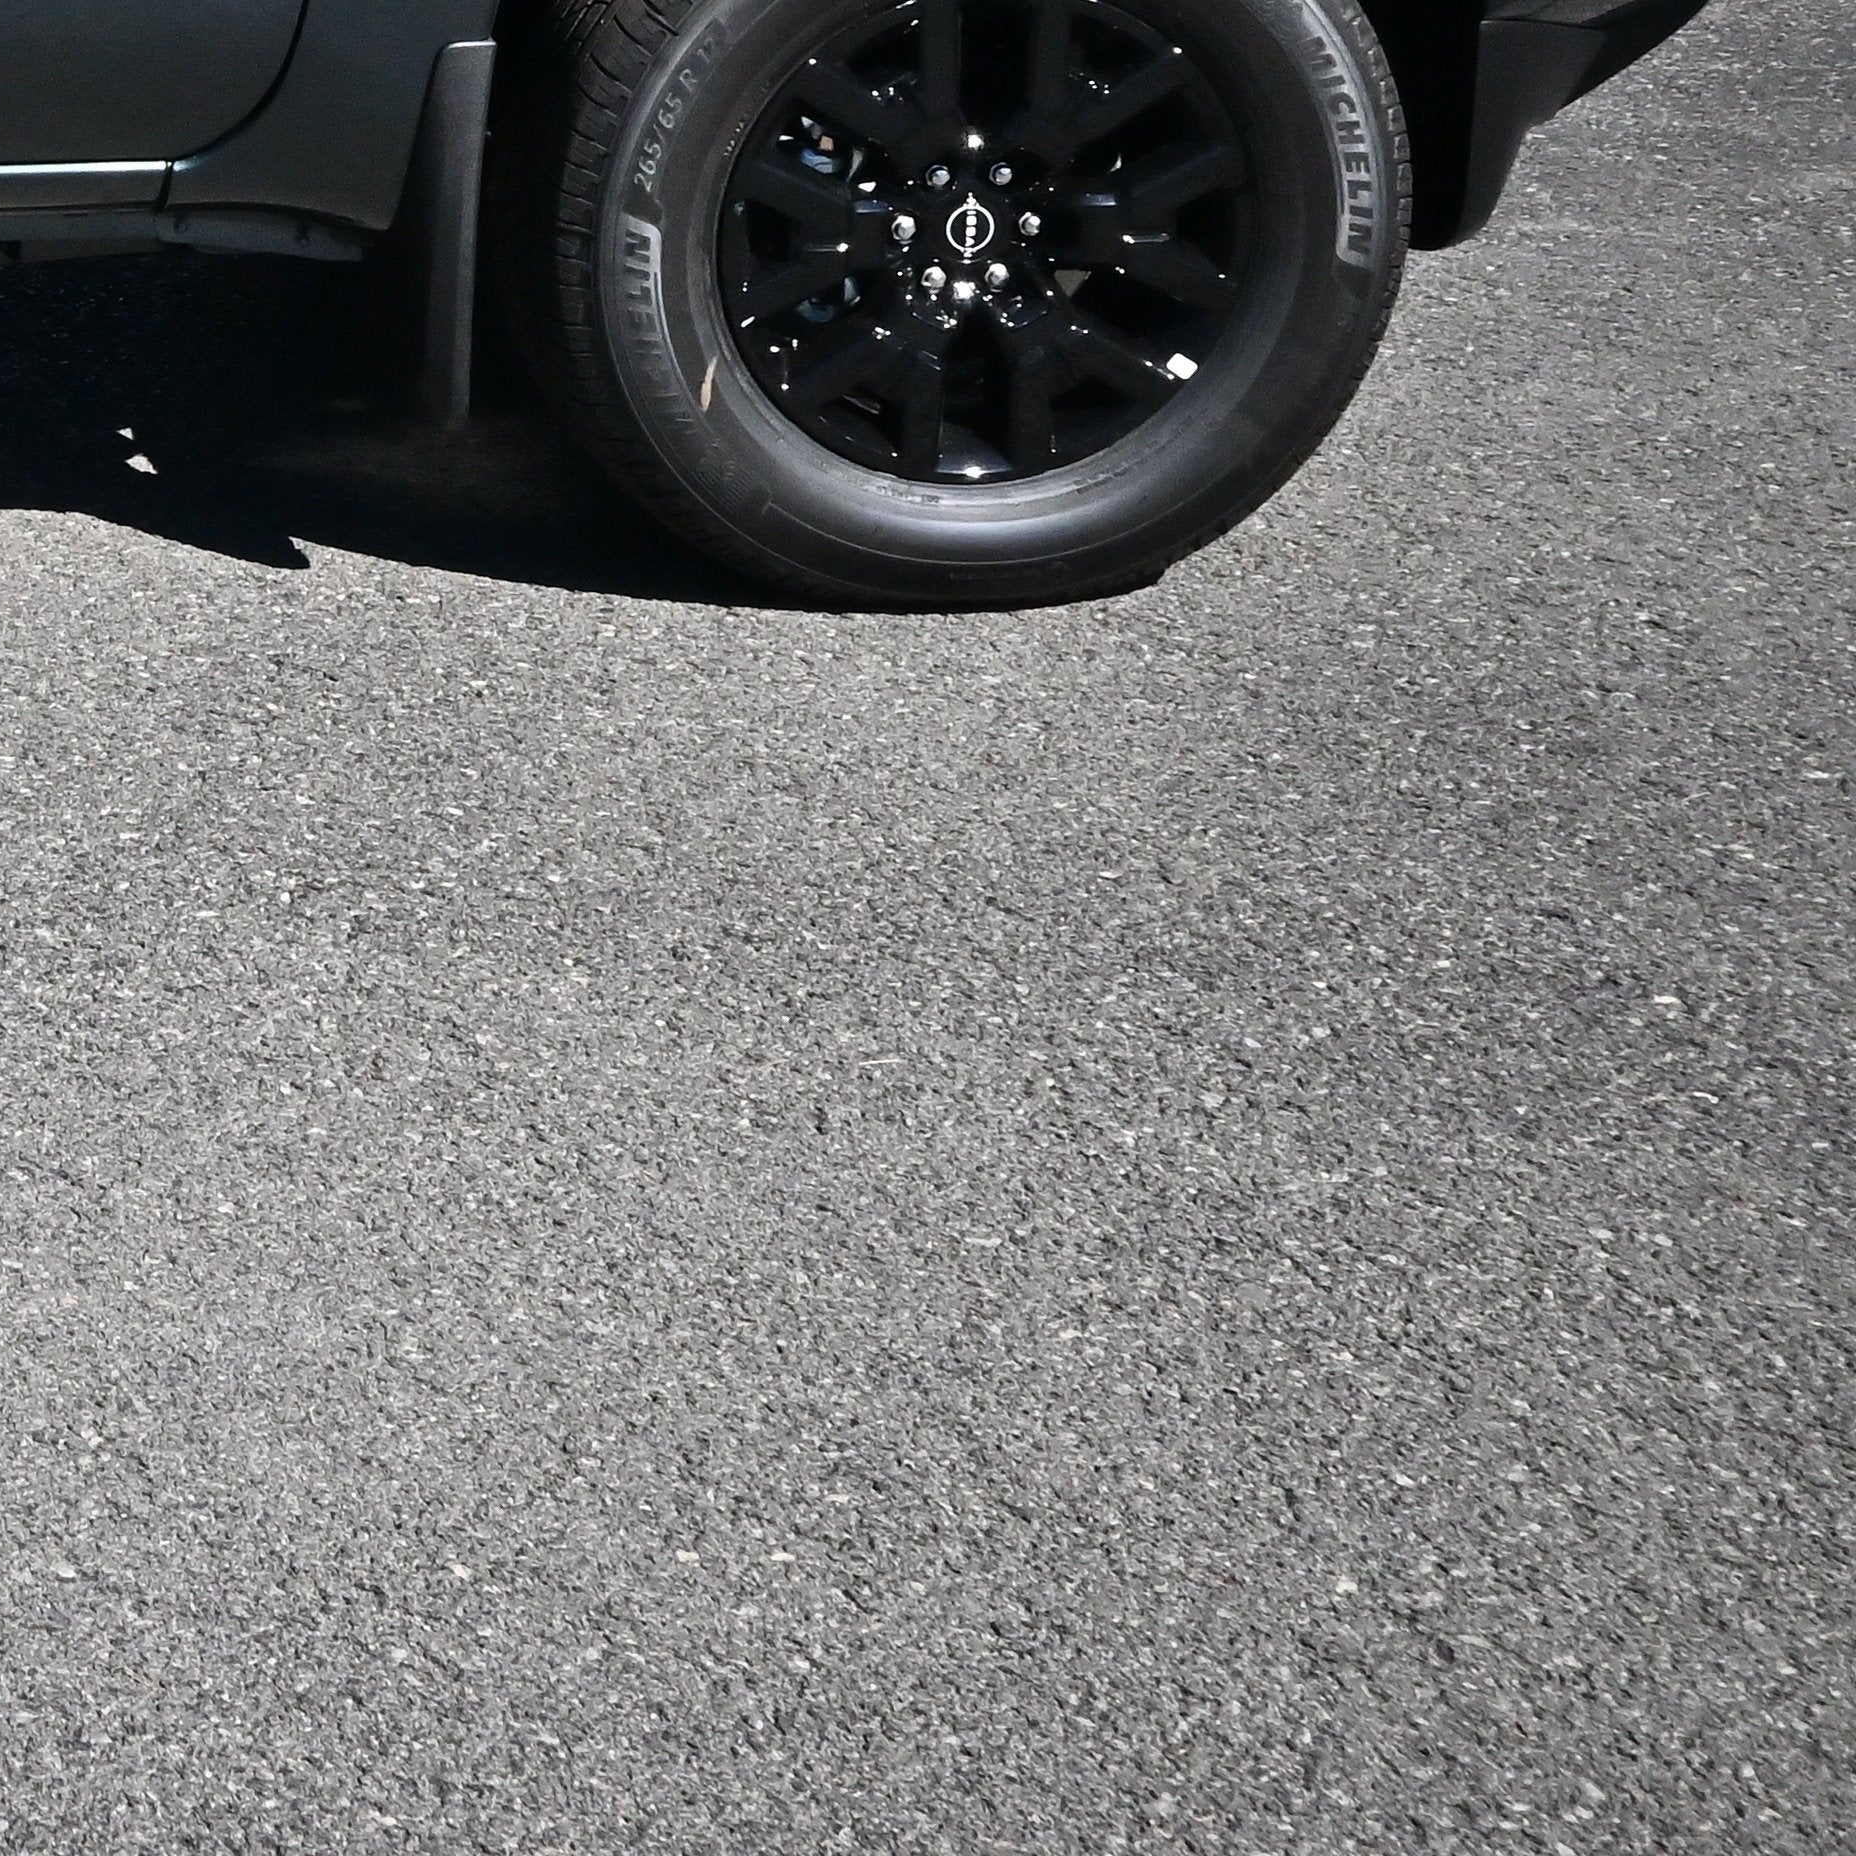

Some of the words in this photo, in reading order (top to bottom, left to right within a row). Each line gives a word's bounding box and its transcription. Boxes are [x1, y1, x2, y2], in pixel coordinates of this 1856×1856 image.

[634, 92, 682, 193] 265/65
[679, 67, 698, 92] R
[1303, 35, 1375, 255] MICHELIN
